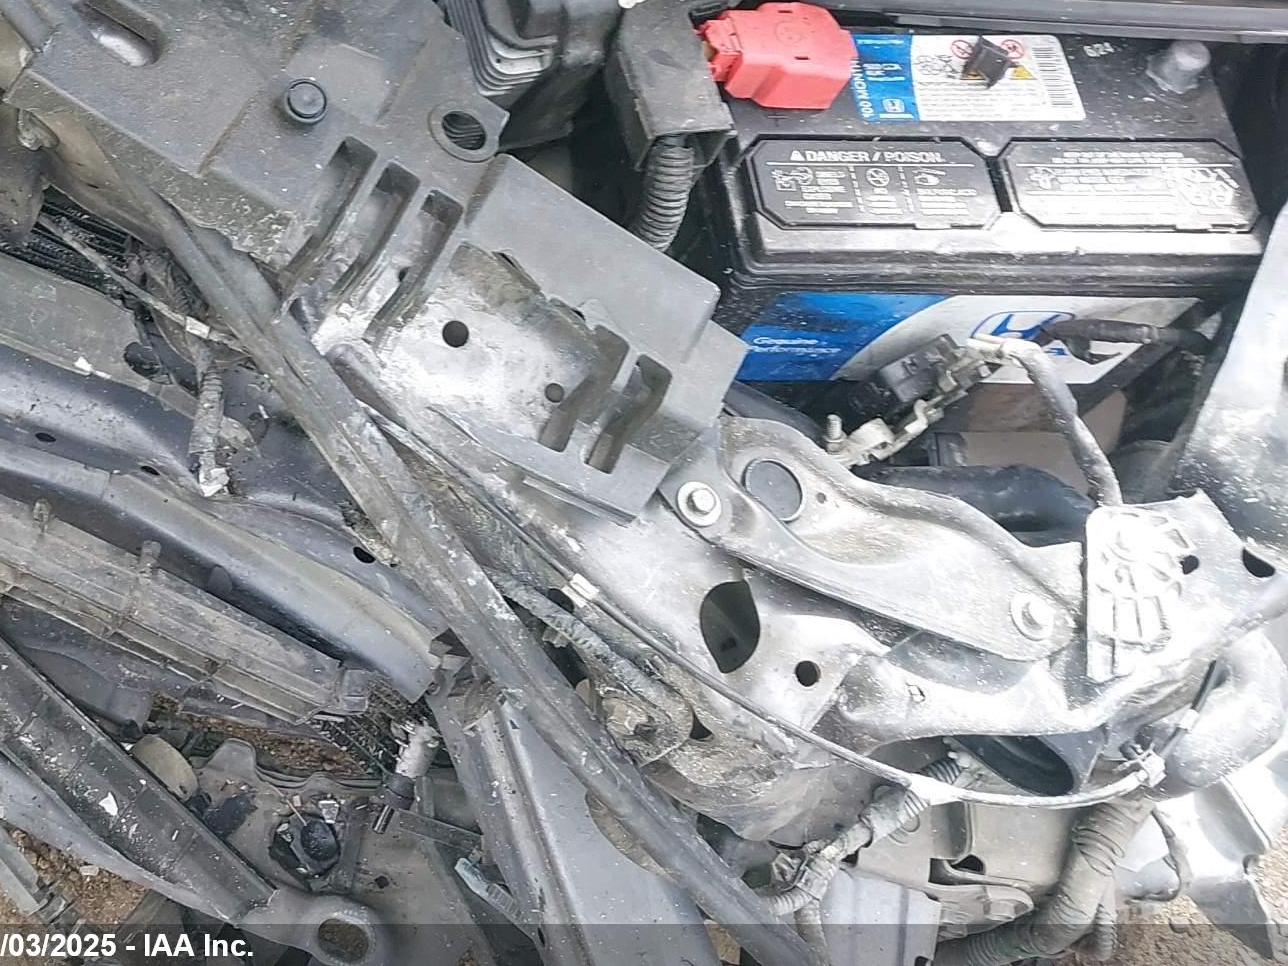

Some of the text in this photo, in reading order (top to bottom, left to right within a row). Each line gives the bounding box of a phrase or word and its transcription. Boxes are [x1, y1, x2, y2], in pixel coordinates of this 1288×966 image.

[858, 100, 875, 118] 100
[805, 150, 870, 163] DANGER
[884, 151, 942, 163] POISON
[753, 336, 819, 345] Genuine
